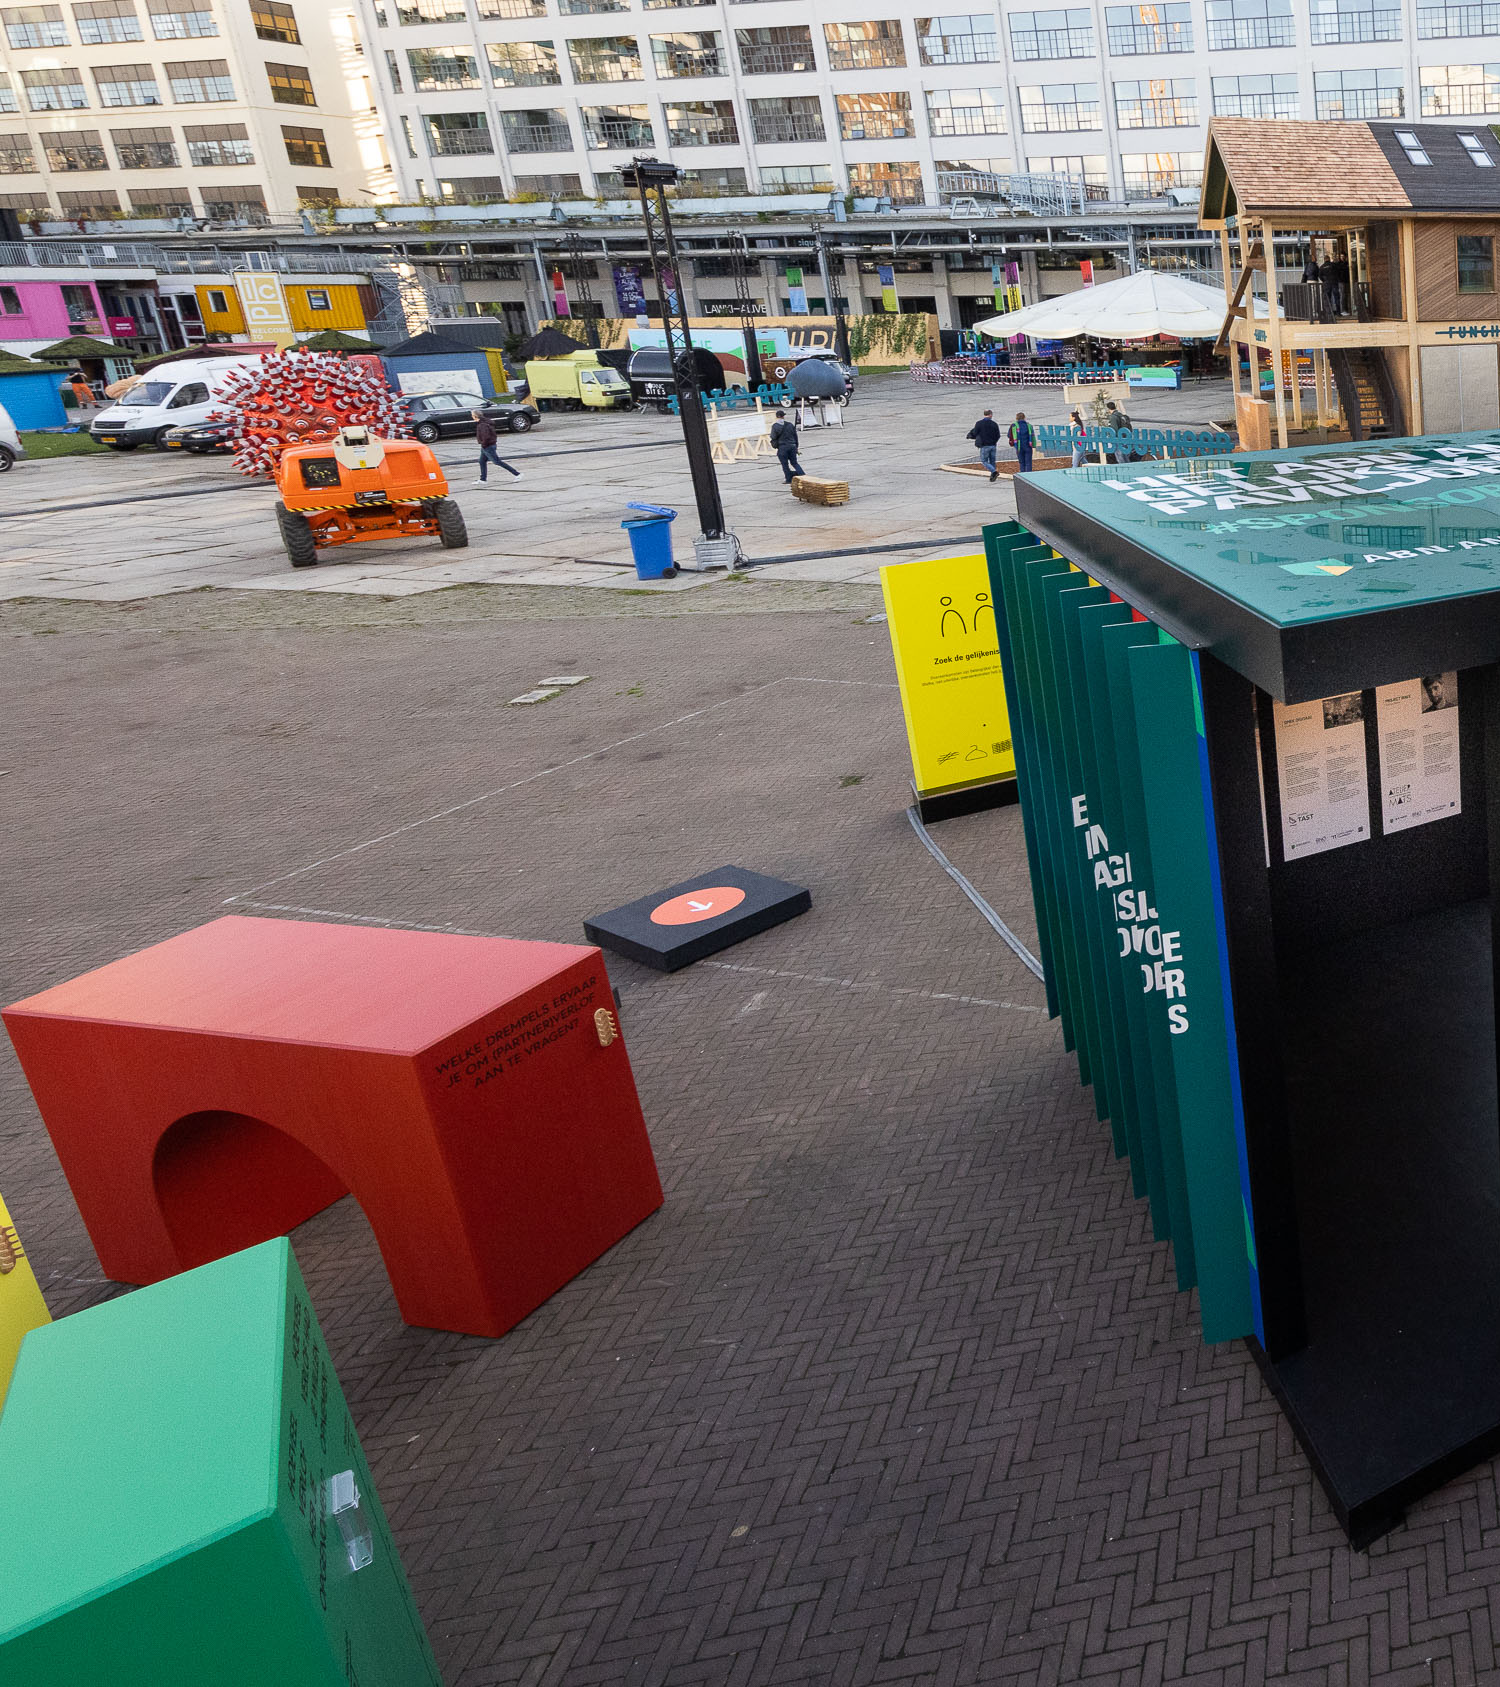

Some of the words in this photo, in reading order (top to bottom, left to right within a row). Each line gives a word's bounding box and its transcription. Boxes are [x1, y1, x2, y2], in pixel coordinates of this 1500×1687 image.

[1038, 425, 1234, 455] NEIGHBOURHOOD
[1100, 467, 1250, 492] HET
[1273, 451, 1429, 475] ABN
[1126, 462, 1424, 501] GELIJKE
[933, 652, 953, 666] Zoek
[954, 652, 964, 662] de
[1298, 813, 1314, 823] TAST
[1388, 795, 1412, 807] MATS
[435, 1042, 481, 1075] WELKE
[485, 1003, 550, 1047] DREMPELS
[553, 975, 598, 1009] ERVAAR
[447, 1074, 461, 1089] JE
[466, 1055, 489, 1076] OM
[492, 992, 596, 1062] (PARTNER)VERLOF
[474, 1063, 504, 1089] AAN
[507, 1054, 522, 1068] TE
[524, 1017, 580, 1056] VRAGEN?
